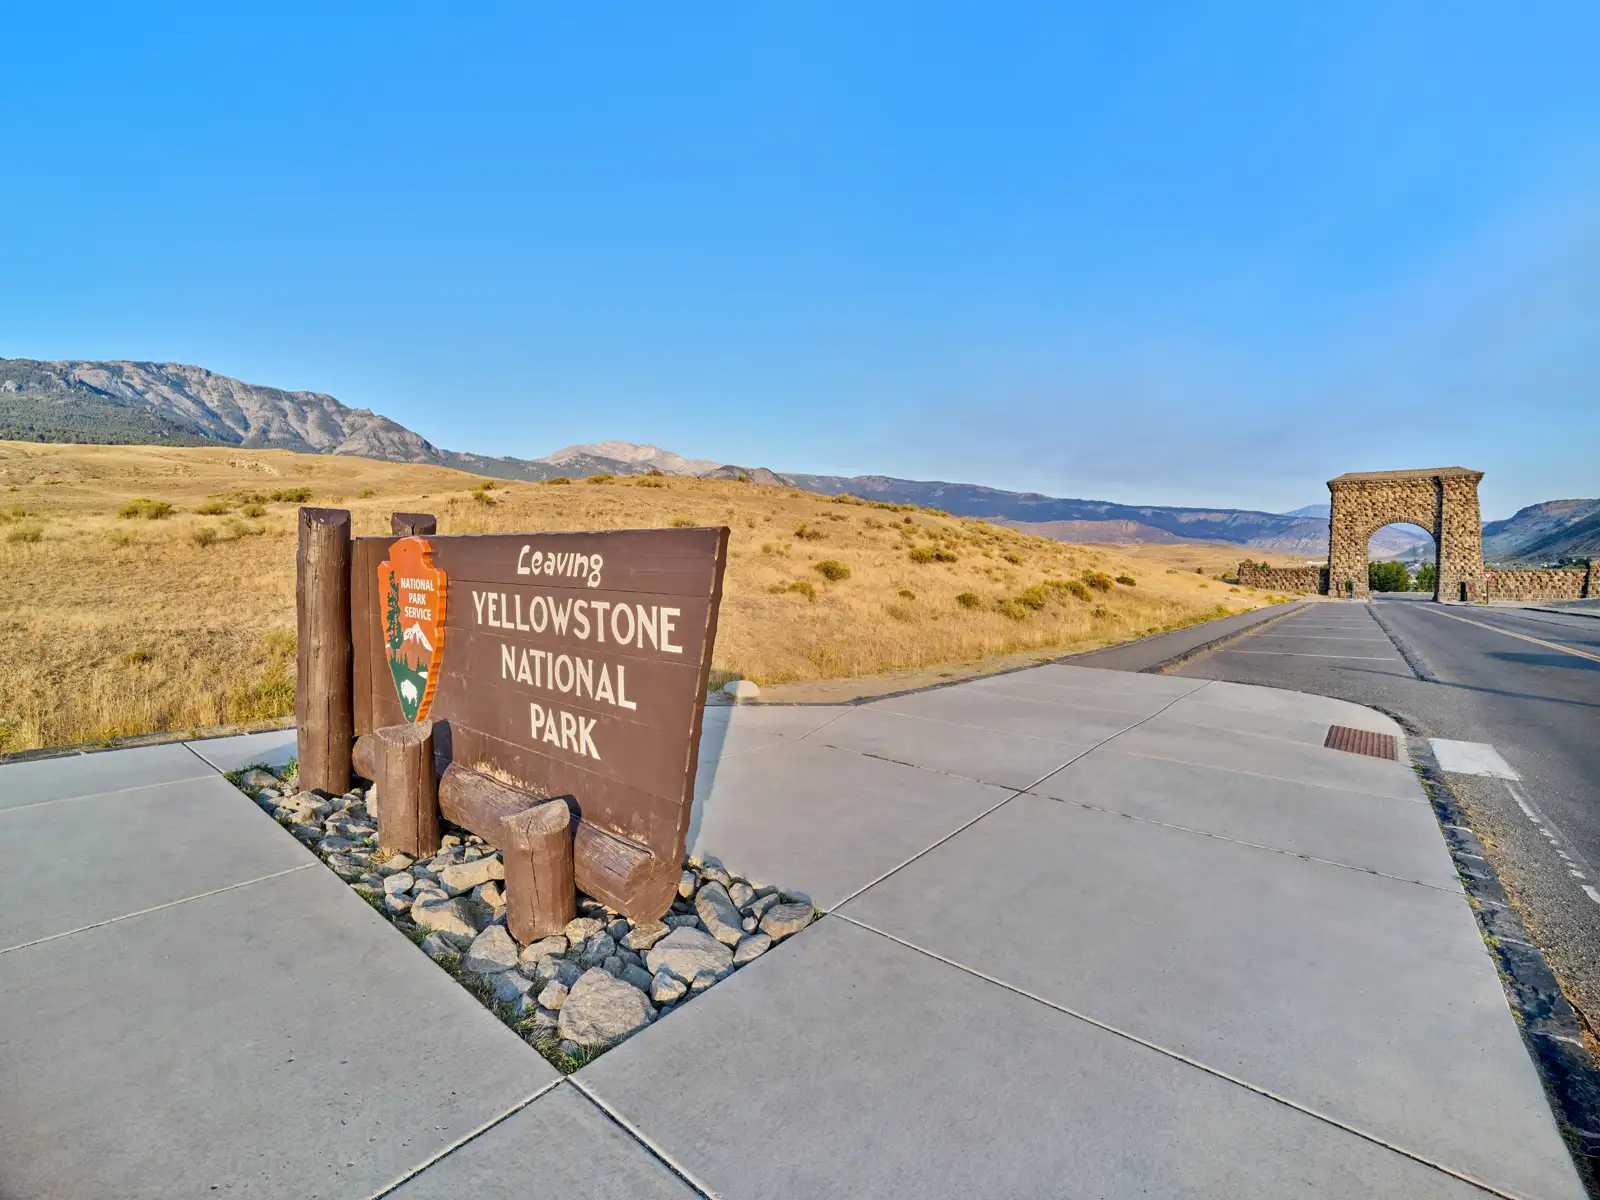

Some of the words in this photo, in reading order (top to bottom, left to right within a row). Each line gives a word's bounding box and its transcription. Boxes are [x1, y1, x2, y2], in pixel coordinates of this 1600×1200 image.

[401, 578, 434, 591] NATIONAL
[516, 545, 603, 587] Leaving
[405, 606, 432, 620] SERVICE
[409, 593, 426, 605] PARK
[472, 590, 683, 654] YELLOWSTONE
[501, 643, 636, 710] NATIONAL
[530, 703, 601, 760] PARK
